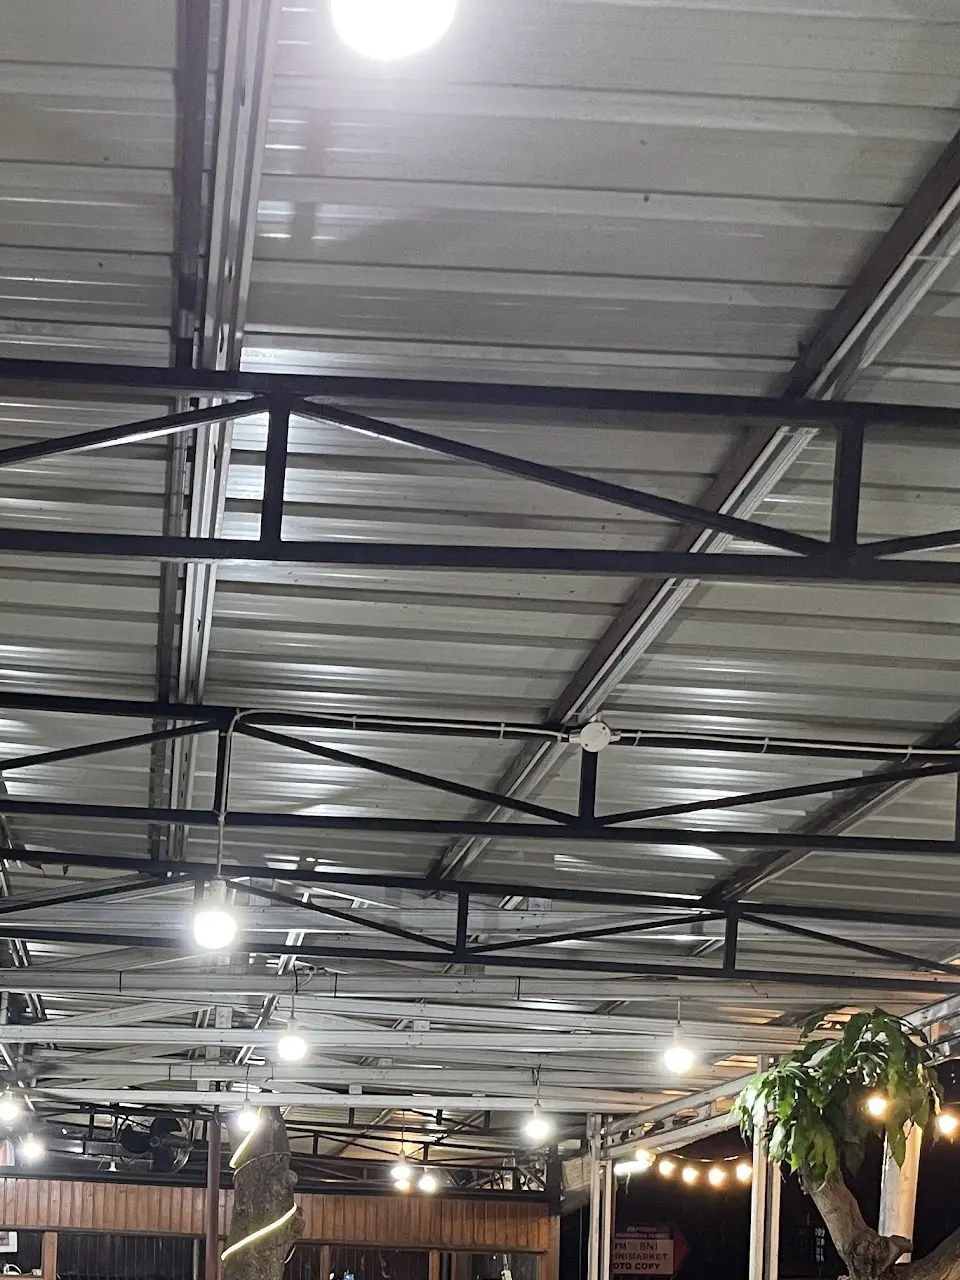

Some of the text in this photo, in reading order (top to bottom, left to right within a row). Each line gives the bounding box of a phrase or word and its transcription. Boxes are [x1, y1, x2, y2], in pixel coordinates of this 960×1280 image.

[614, 1241, 658, 1250] TM BNI
[615, 1253, 668, 1261] INIMARKET
[613, 1262, 660, 1270] OTO COPY
